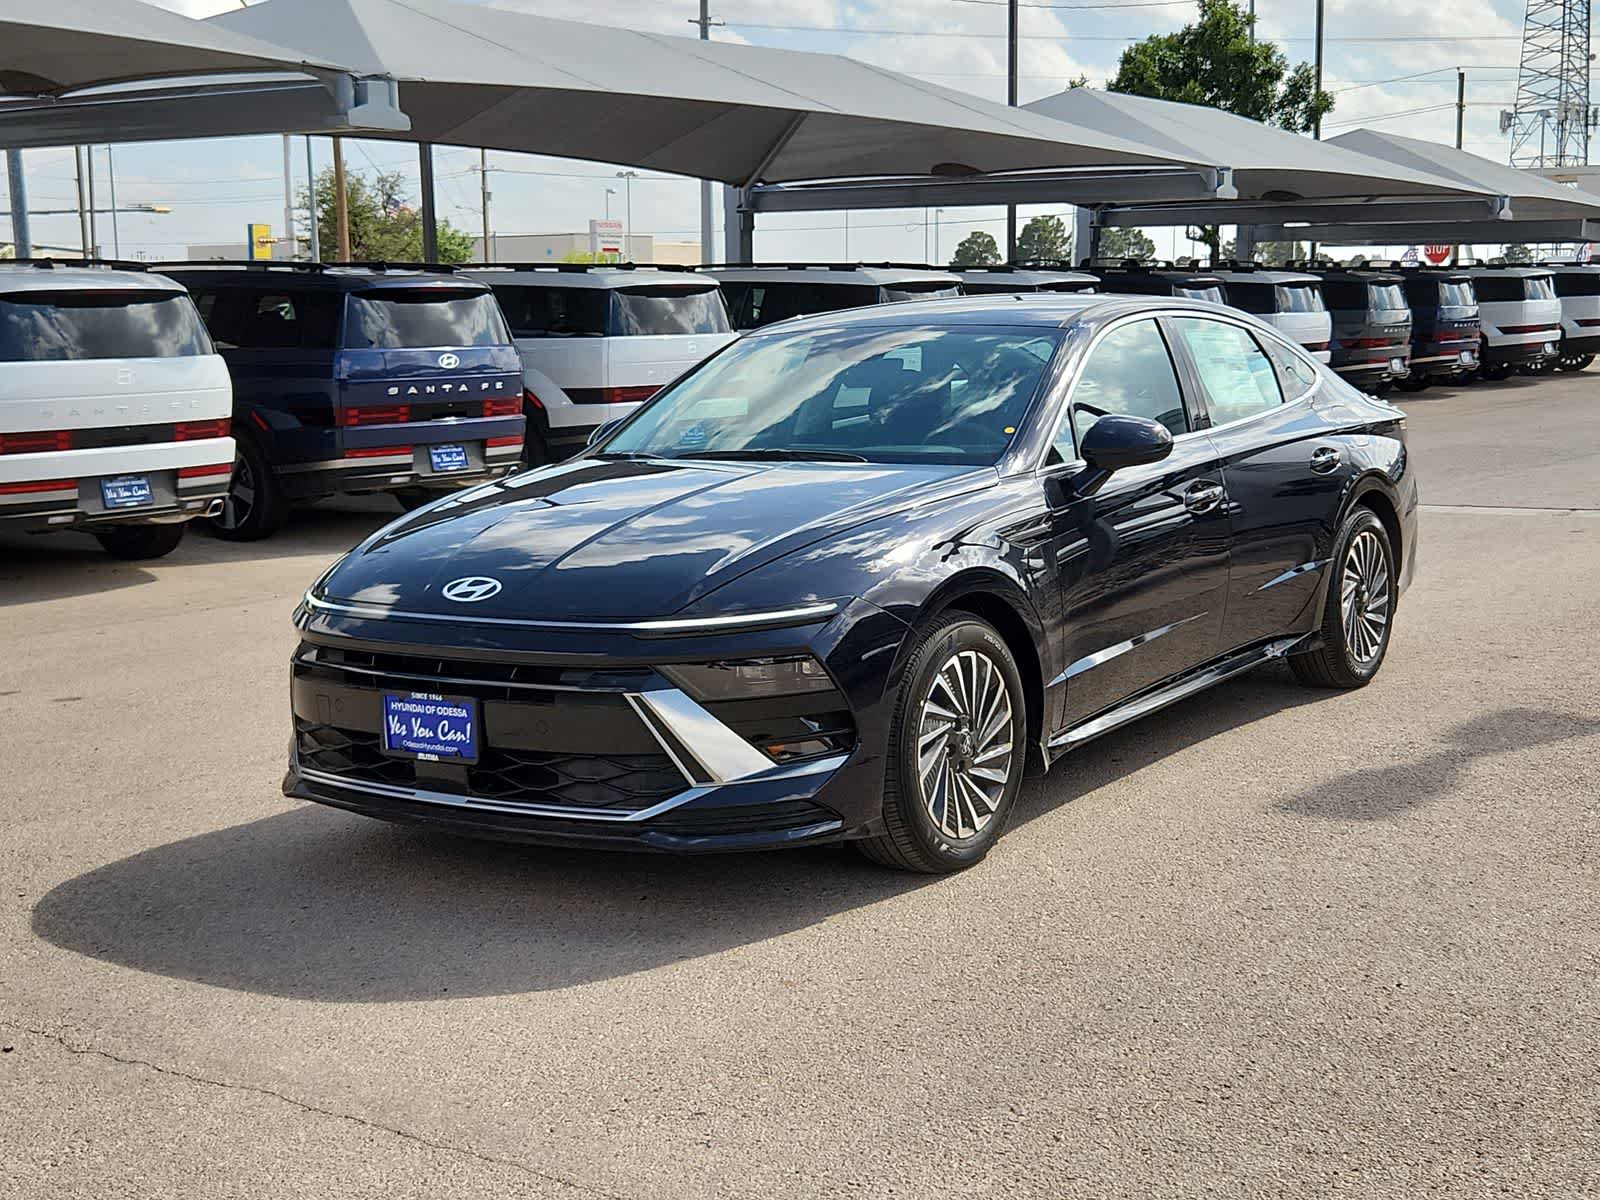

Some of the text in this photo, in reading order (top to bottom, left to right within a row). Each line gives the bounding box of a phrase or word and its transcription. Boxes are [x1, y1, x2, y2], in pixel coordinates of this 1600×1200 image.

[1425, 244, 1449, 255] STOP
[387, 382, 503, 396] SANTA FE
[411, 692, 428, 700] SINCE
[391, 702, 468, 718] HYUNDAI OF ODESSA
[388, 714, 471, 743] Yes You Can!
